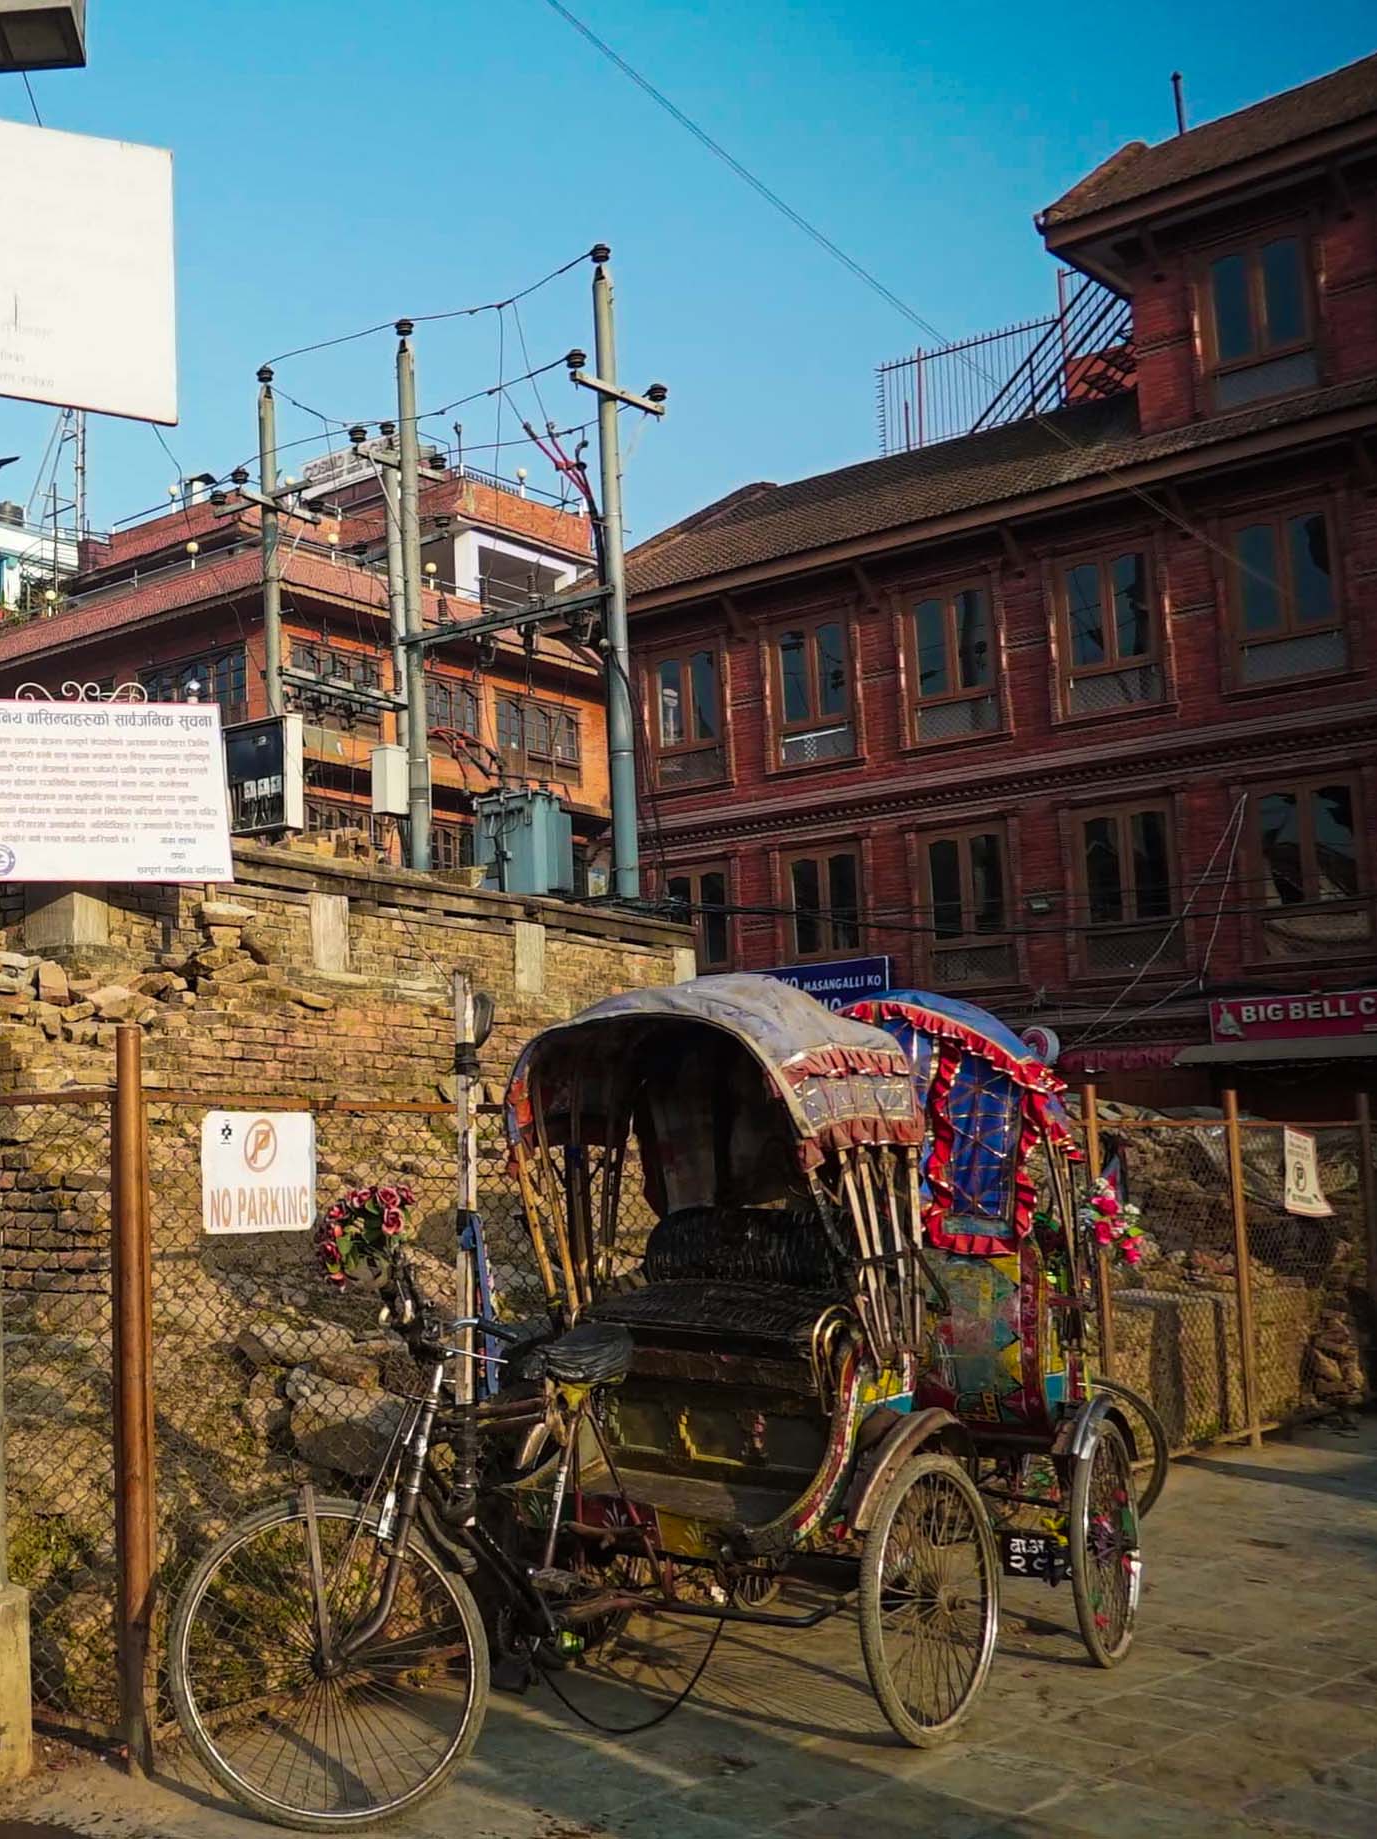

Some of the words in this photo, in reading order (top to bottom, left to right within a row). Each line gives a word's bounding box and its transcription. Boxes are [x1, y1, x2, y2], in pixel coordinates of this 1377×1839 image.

[867, 974, 882, 986] KO
[1241, 1003, 1284, 1023] BIG
[1288, 999, 1355, 1020] BELL
[210, 1187, 232, 1228] NO
[237, 1185, 309, 1227] PARKING
